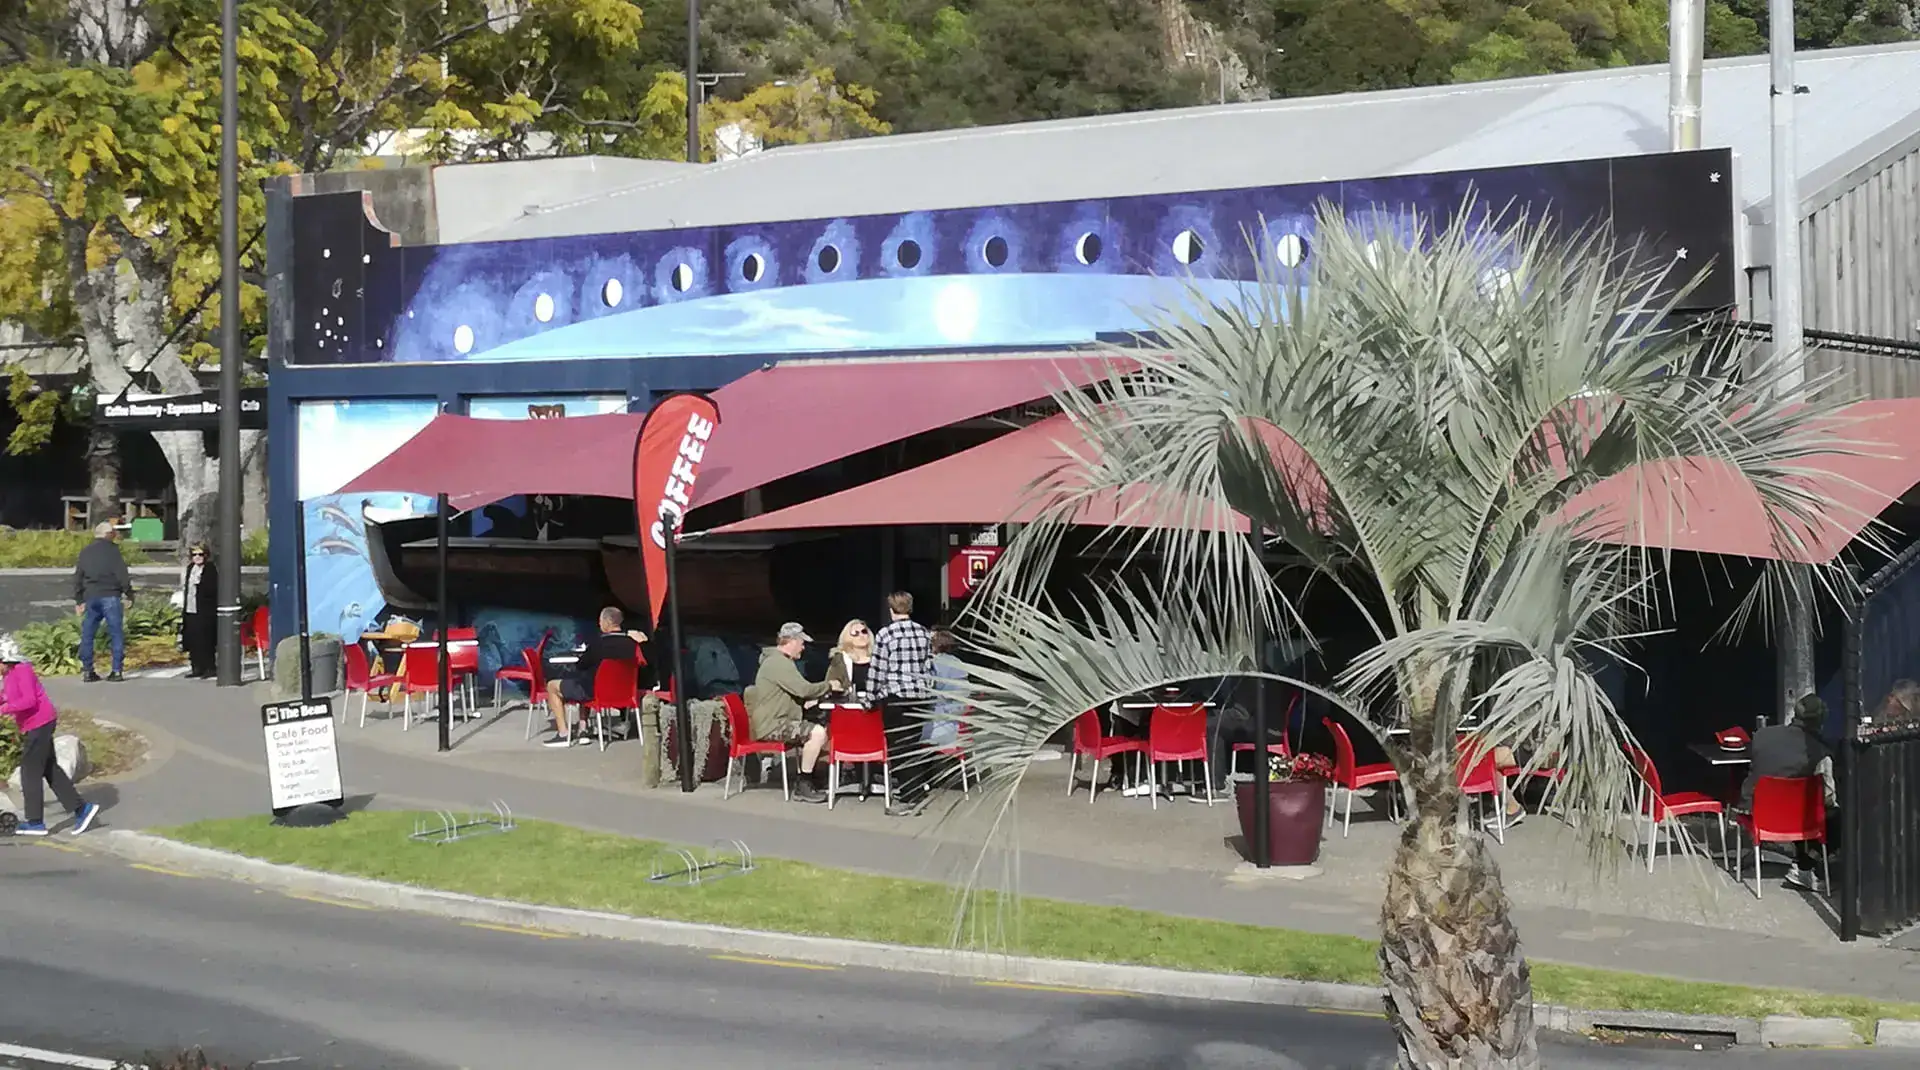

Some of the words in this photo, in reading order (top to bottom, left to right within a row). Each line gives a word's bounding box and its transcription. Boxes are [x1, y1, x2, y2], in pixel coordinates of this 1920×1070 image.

[202, 401, 217, 413] Bar
[650, 411, 714, 550] COFFEE
[279, 707, 300, 720] The
[300, 705, 328, 717] Bean
[301, 724, 329, 737] Food
